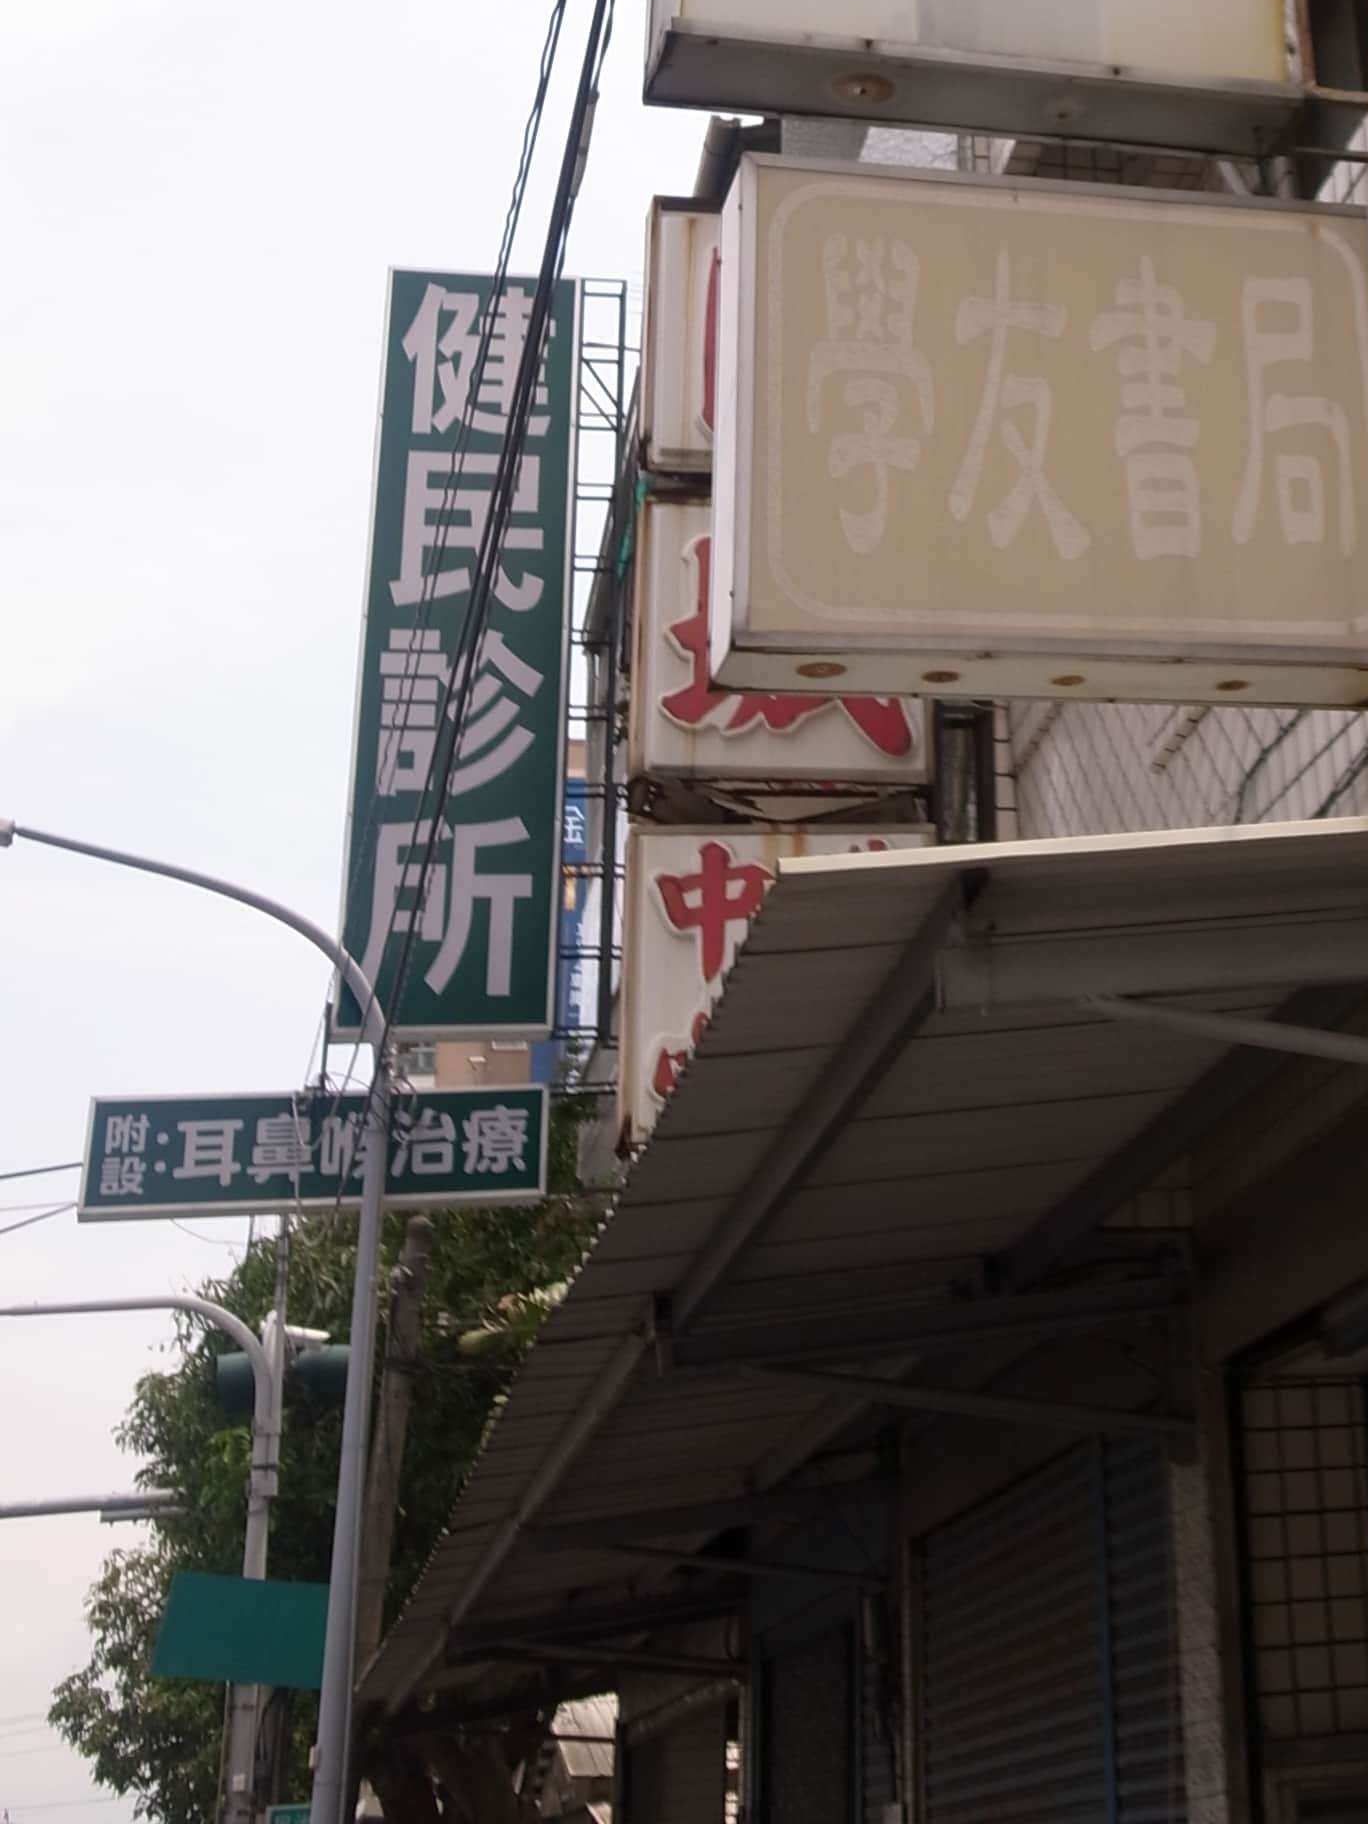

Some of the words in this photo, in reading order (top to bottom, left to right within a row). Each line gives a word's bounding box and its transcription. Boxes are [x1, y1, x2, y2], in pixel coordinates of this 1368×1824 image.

[363, 282, 558, 1000] 健民診所
[804, 232, 1360, 562] 學友書局
